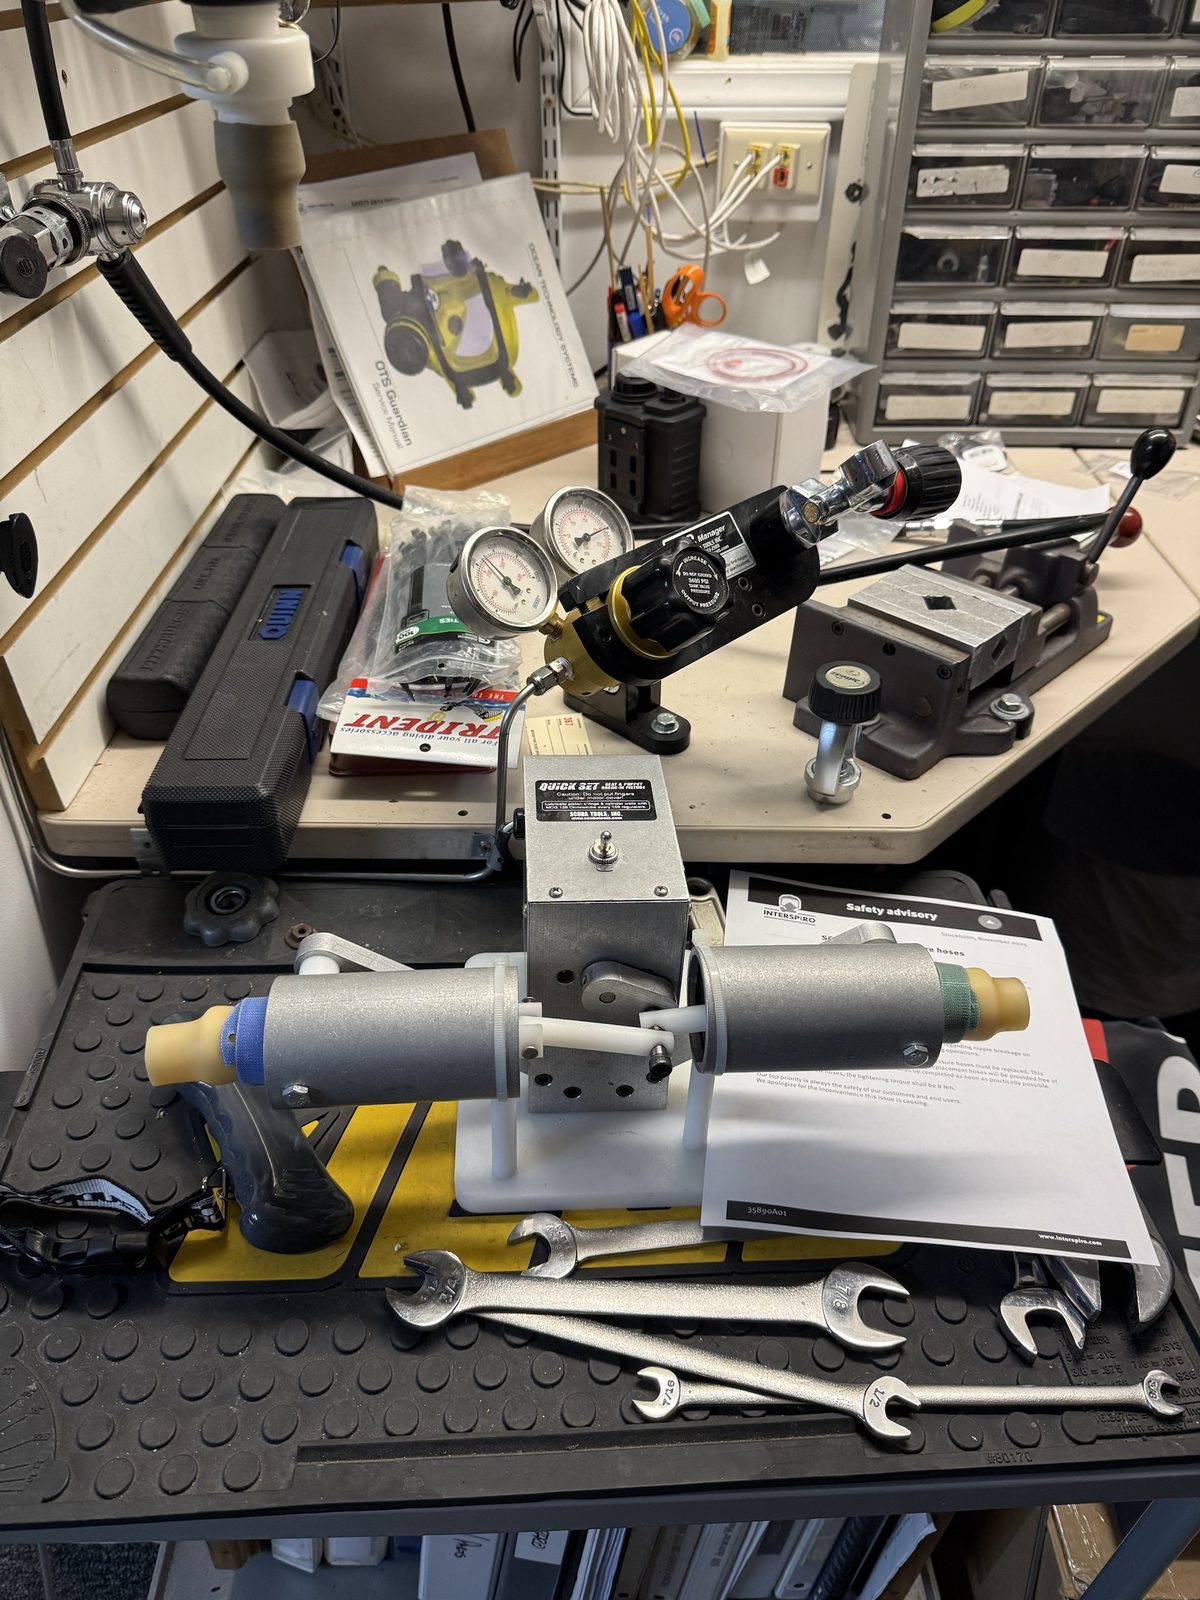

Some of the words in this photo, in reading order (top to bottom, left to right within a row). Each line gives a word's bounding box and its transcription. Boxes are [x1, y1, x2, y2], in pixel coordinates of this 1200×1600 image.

[529, 243, 543, 277] OCEAN
[540, 279, 564, 341] TECHNOLOGY
[560, 344, 579, 389] SYSTEMS
[375, 360, 392, 388] OTS
[386, 390, 413, 446] Guardian
[373, 382, 389, 416] Service
[386, 416, 404, 449] Manual
[697, 525, 725, 542] Manager
[682, 555, 708, 566] INCREASE
[681, 589, 699, 607] OUTPUT
[699, 591, 720, 608] PRESSURE
[258, 587, 305, 640] QUINN
[398, 630, 414, 640] 100
[340, 726, 399, 736] accessories
[344, 713, 501, 740] TRIDENT
[403, 731, 435, 740] diving
[438, 735, 461, 744] your
[538, 782, 578, 791] QUICK
[578, 782, 600, 791] SET
[763, 909, 816, 924] INTERSPIRO
[846, 902, 884, 916] Safety
[886, 906, 938, 921] advisory
[940, 931, 977, 941] Stockholm,
[977, 936, 1010, 944] November
[937, 947, 965, 957] hoses
[943, 1043, 973, 1051] regarding
[993, 1047, 1021, 1057] breakage
[945, 1049, 980, 1057] operations.
[1001, 1066, 1030, 1075] replaced.
[1009, 1073, 1037, 1082] provided
[780, 1075, 802, 1084] priority
[810, 1079, 831, 1088] always
[843, 1082, 862, 1092] safety
[882, 1089, 915, 1098] customers
[857, 1073, 889, 1084] tightening
[889, 1078, 911, 1086] torque
[921, 1069, 954, 1079] completed
[989, 1077, 1021, 1087] practically
[1022, 1082, 1051, 1090] possible.
[766, 1079, 797, 1088] apologize
[819, 1085, 864, 1098] inconvenience
[902, 1099, 930, 1108] causing.
[747, 1206, 788, 1217] 35890A01
[1038, 1233, 1103, 1247] www.interspiro.com
[832, 1285, 851, 1310] 7/8
[662, 1379, 676, 1407] 7/16
[869, 1387, 886, 1408] 1/2
